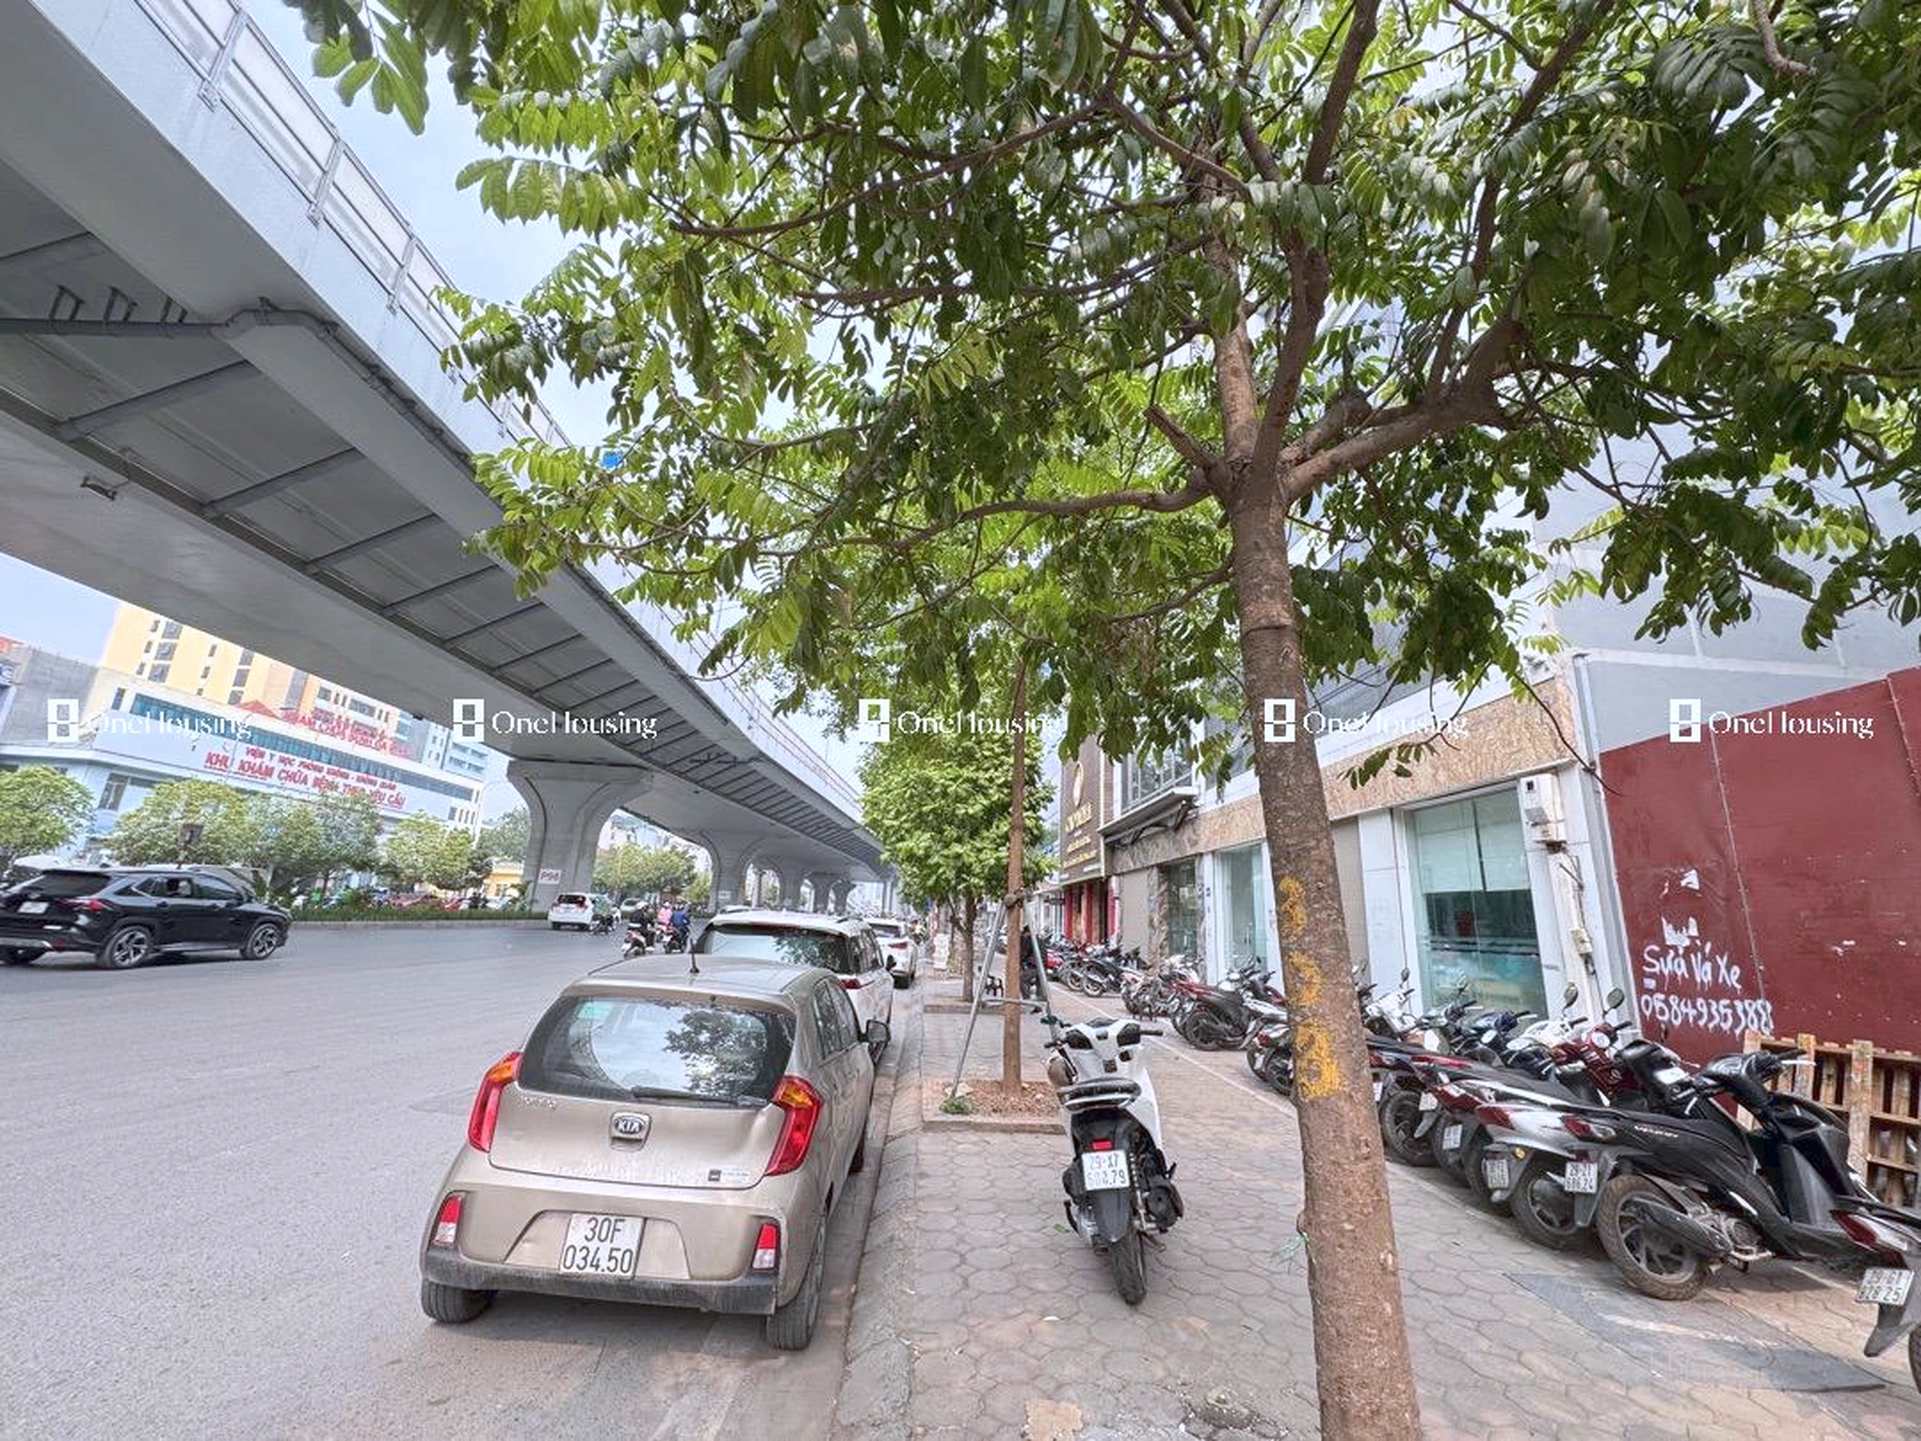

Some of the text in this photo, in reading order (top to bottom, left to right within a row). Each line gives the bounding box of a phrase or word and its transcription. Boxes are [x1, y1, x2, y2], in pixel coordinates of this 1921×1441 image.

[204, 751, 230, 770] KHU
[238, 758, 275, 778] KHÁM
[277, 767, 309, 786] CHỮA
[616, 1121, 641, 1134] KIA
[584, 1216, 626, 1244] 30F
[562, 1244, 634, 1274] 034.50
